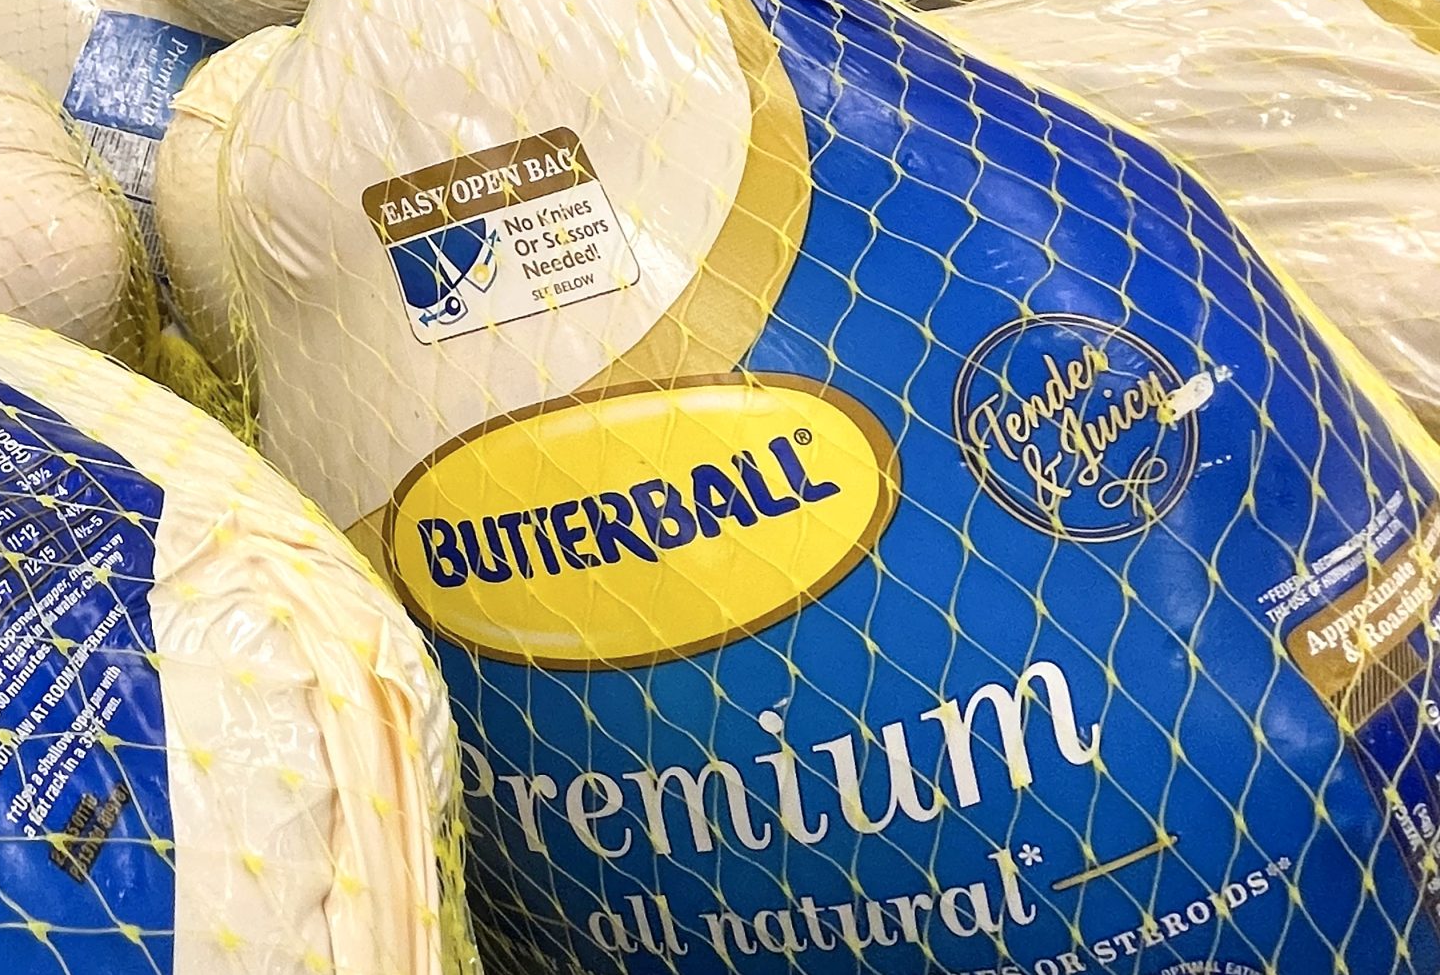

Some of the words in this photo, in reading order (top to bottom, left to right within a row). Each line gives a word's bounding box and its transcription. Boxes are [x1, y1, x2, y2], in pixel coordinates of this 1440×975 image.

[380, 184, 446, 226] EASY
[451, 164, 522, 204] OPEN
[503, 216, 534, 236] No
[536, 199, 592, 225] Knives
[514, 236, 538, 256] Or
[542, 219, 609, 246] Scssors
[522, 245, 602, 280] Needed!
[554, 273, 595, 296] BELOW
[968, 345, 1106, 461] Tender
[1022, 443, 1071, 513] &
[7, 524, 40, 550] 11-12
[24, 546, 56, 576] 12-15
[3, 636, 34, 677] thaw
[54, 587, 87, 617] water,
[1306, 561, 1417, 657] Approximate
[8, 644, 53, 697] minutes.
[1342, 638, 1361, 664] &
[45, 667, 78, 709] ROOM
[38, 730, 75, 776] shallow
[100, 665, 122, 690] with
[44, 764, 71, 803] rack
[101, 697, 122, 723] oven.
[453, 660, 1101, 858] Premium
[587, 893, 689, 958] all
[1034, 946, 1088, 975] OR
